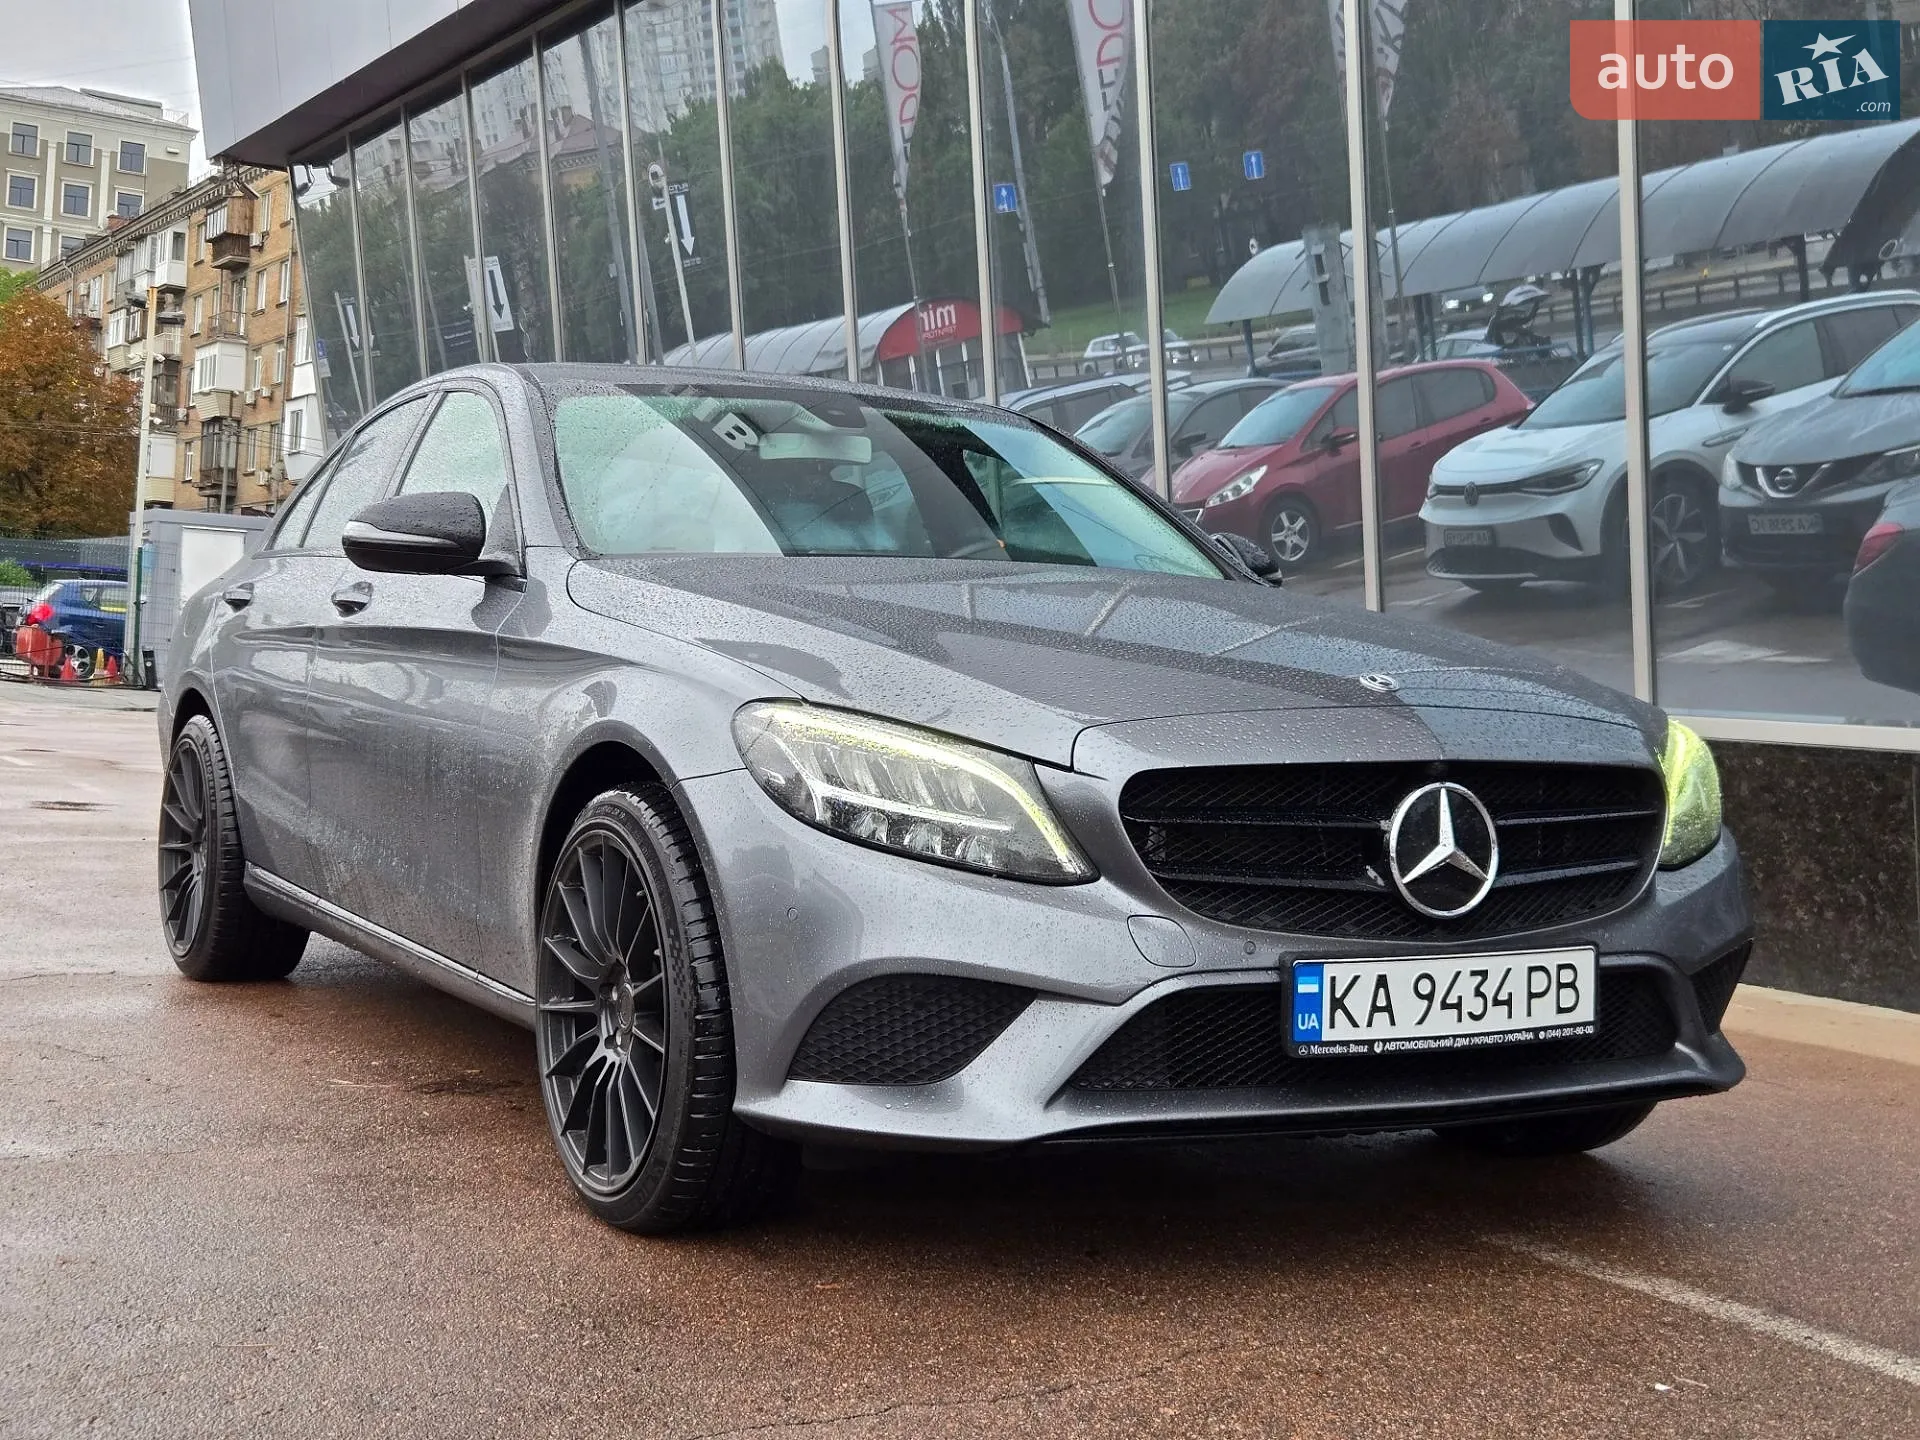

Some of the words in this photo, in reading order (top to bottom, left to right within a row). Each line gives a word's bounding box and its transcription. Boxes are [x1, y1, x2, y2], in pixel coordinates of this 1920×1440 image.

[1329, 974, 1396, 1030] KA
[1413, 967, 1512, 1026] 9434
[1526, 963, 1580, 1018] PB
[1298, 1013, 1319, 1030] UA
[1310, 1044, 1368, 1054] Mercedes-Benz
